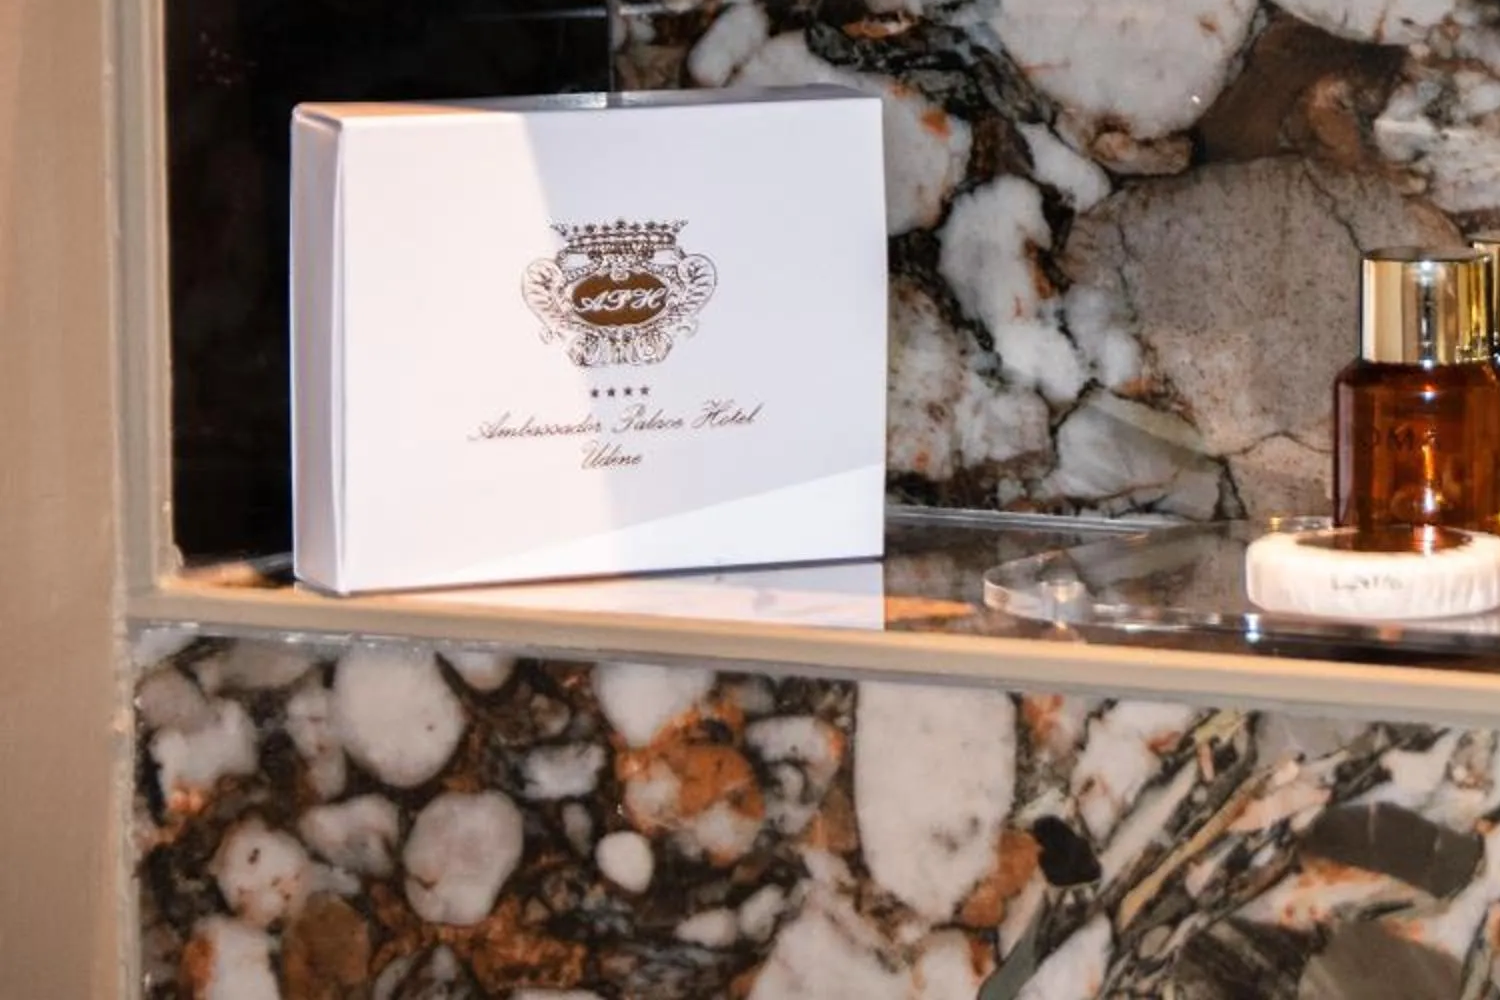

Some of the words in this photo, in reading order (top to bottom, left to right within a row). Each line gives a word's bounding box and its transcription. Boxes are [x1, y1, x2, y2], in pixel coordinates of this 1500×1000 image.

[468, 411, 601, 440] Ambassador
[612, 403, 684, 434] Palace
[691, 399, 765, 429] Hotel
[581, 440, 643, 469] Udine
